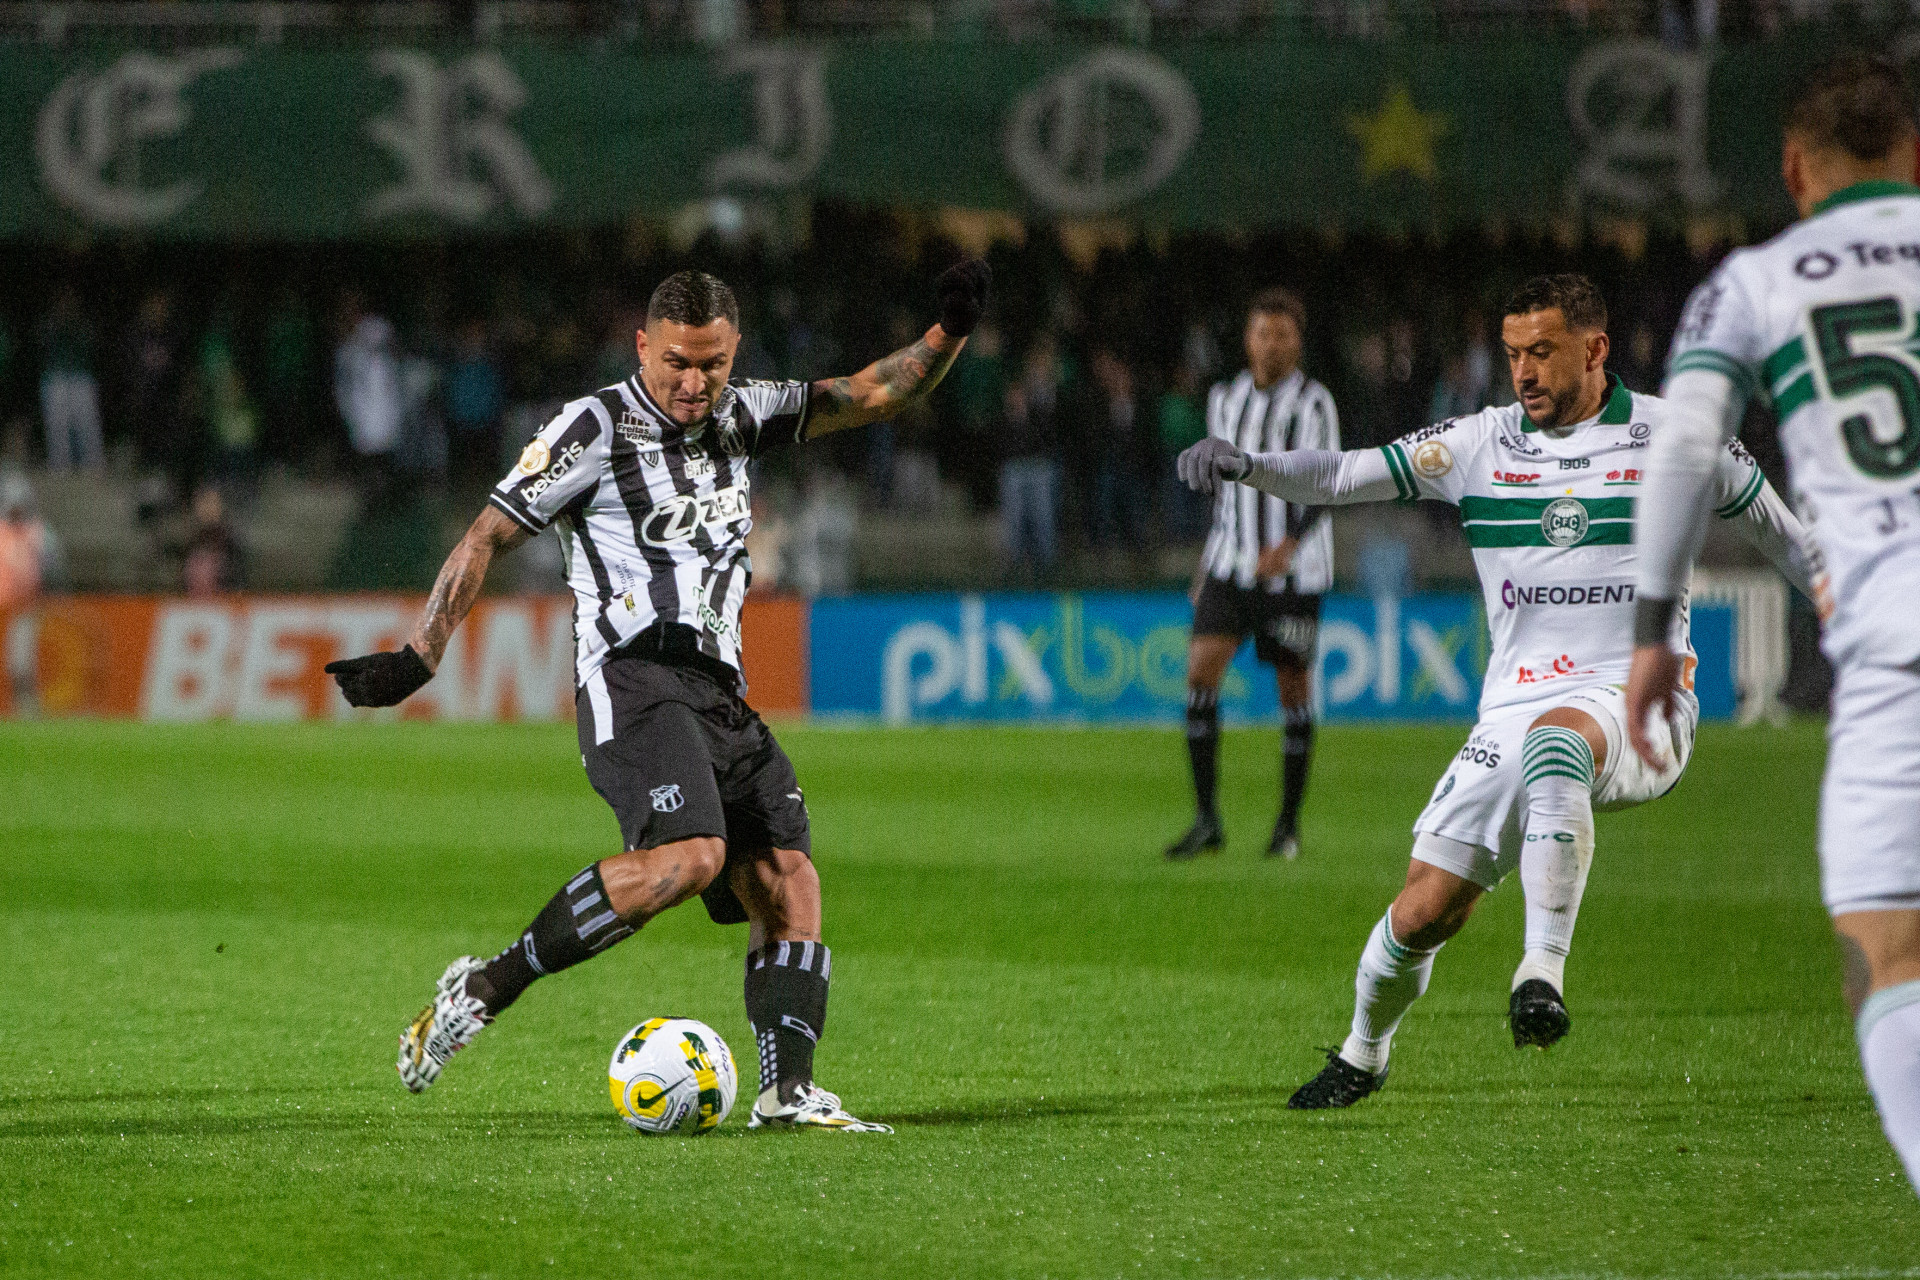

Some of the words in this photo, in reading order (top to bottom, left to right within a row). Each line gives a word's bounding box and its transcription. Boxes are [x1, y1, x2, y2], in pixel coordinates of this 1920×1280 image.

[617, 424, 650, 435] Freitas
[1559, 458, 1590, 470] 1909
[520, 441, 584, 503] betcris
[1504, 471, 1541, 483] RDP
[1551, 516, 1578, 529] CFC
[1517, 584, 1636, 605] NEODENT
[880, 590, 1248, 726] pixbe
